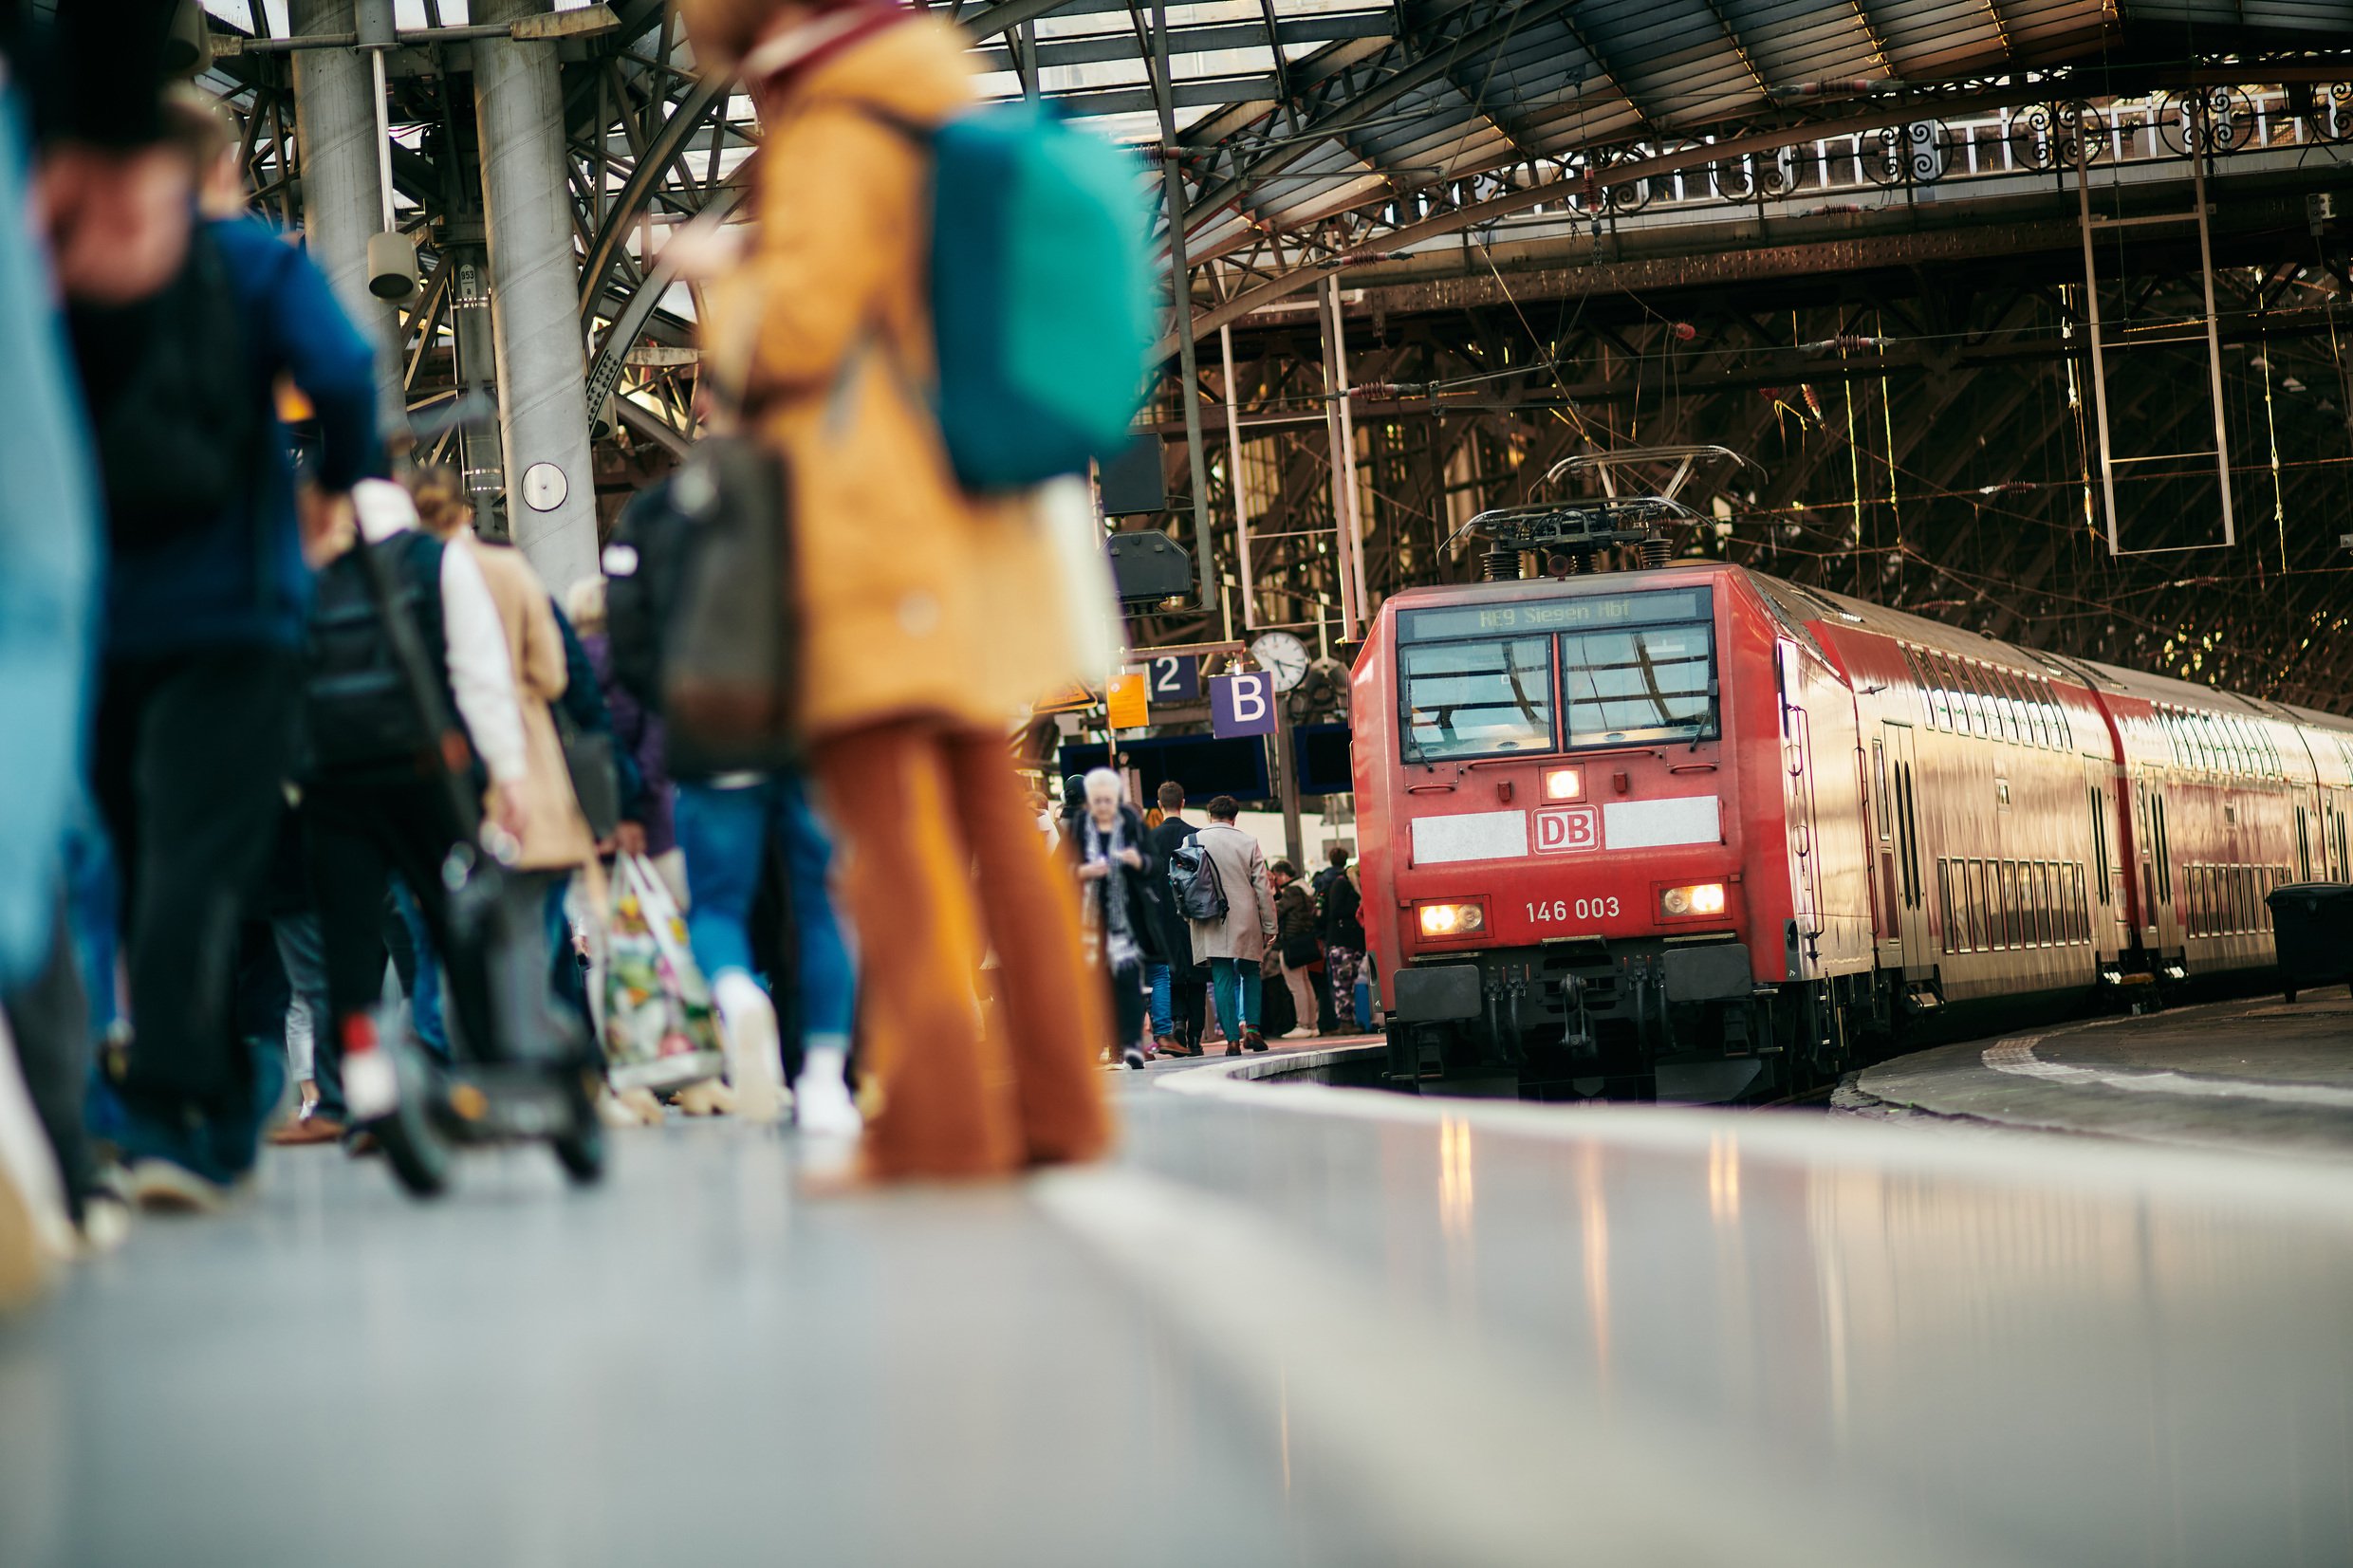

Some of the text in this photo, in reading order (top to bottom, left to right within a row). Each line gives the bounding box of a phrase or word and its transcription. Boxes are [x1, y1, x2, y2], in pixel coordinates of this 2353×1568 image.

[1524, 604, 1590, 624] Siegen
[1598, 599, 1631, 618] Hbf
[1155, 656, 1182, 692] 2
[1231, 674, 1267, 723] B
[1541, 814, 1591, 846] DB
[1526, 895, 1621, 924] 146 003
